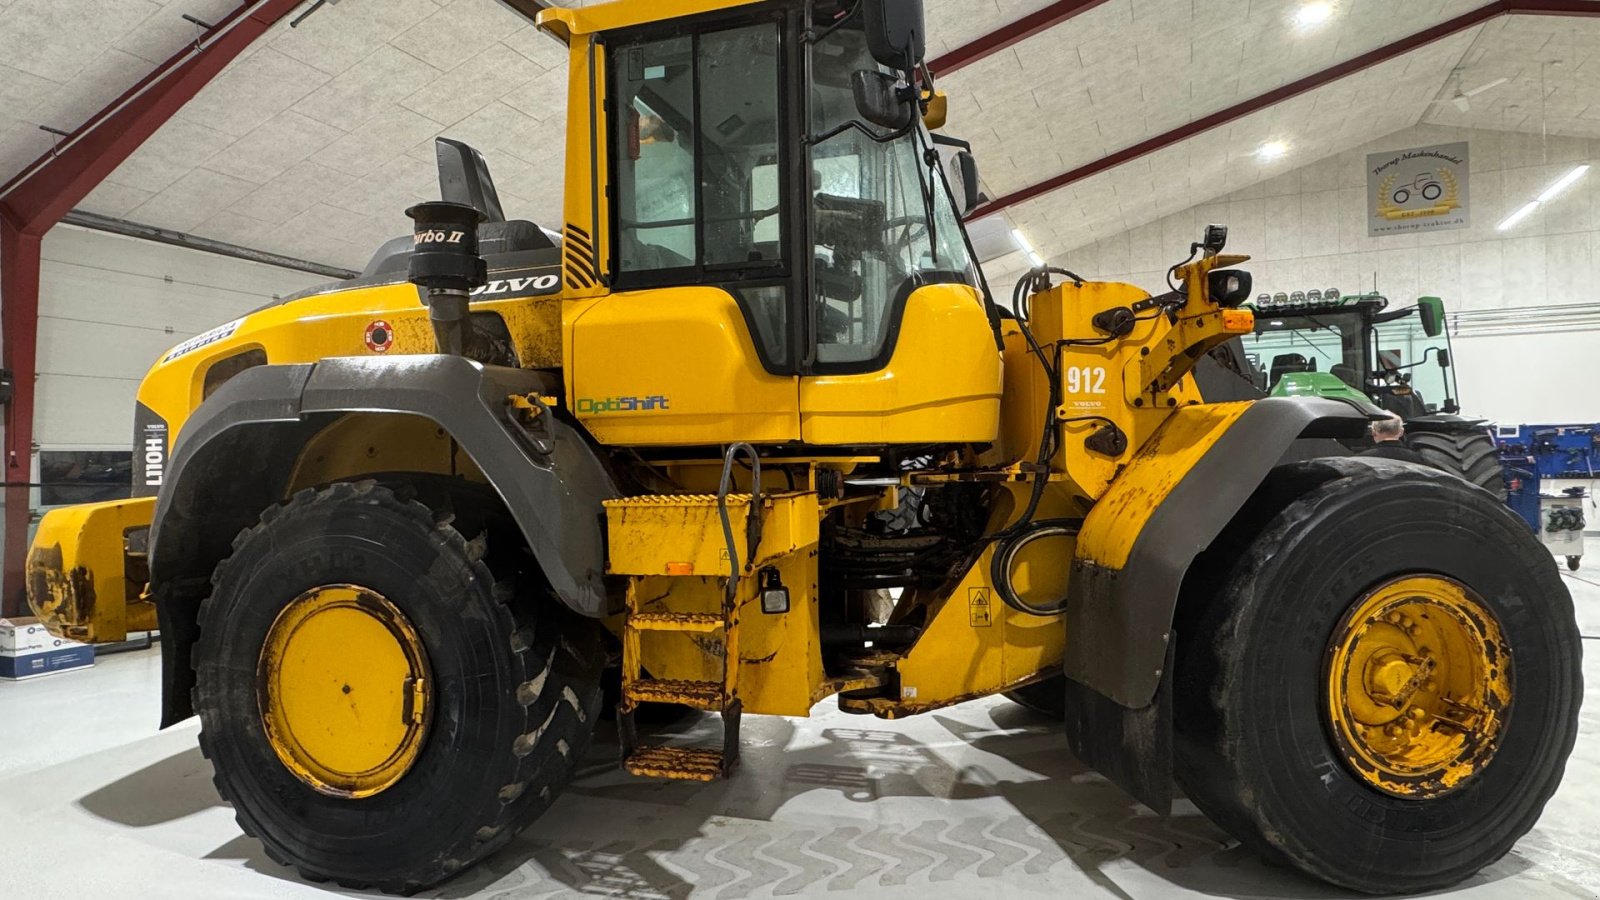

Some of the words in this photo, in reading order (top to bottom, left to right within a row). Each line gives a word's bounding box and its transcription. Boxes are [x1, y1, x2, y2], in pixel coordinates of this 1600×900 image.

[414, 229, 446, 244] urbo
[1067, 366, 1106, 394] 912
[577, 395, 670, 414] OptiShift
[145, 438, 163, 486] L110H
